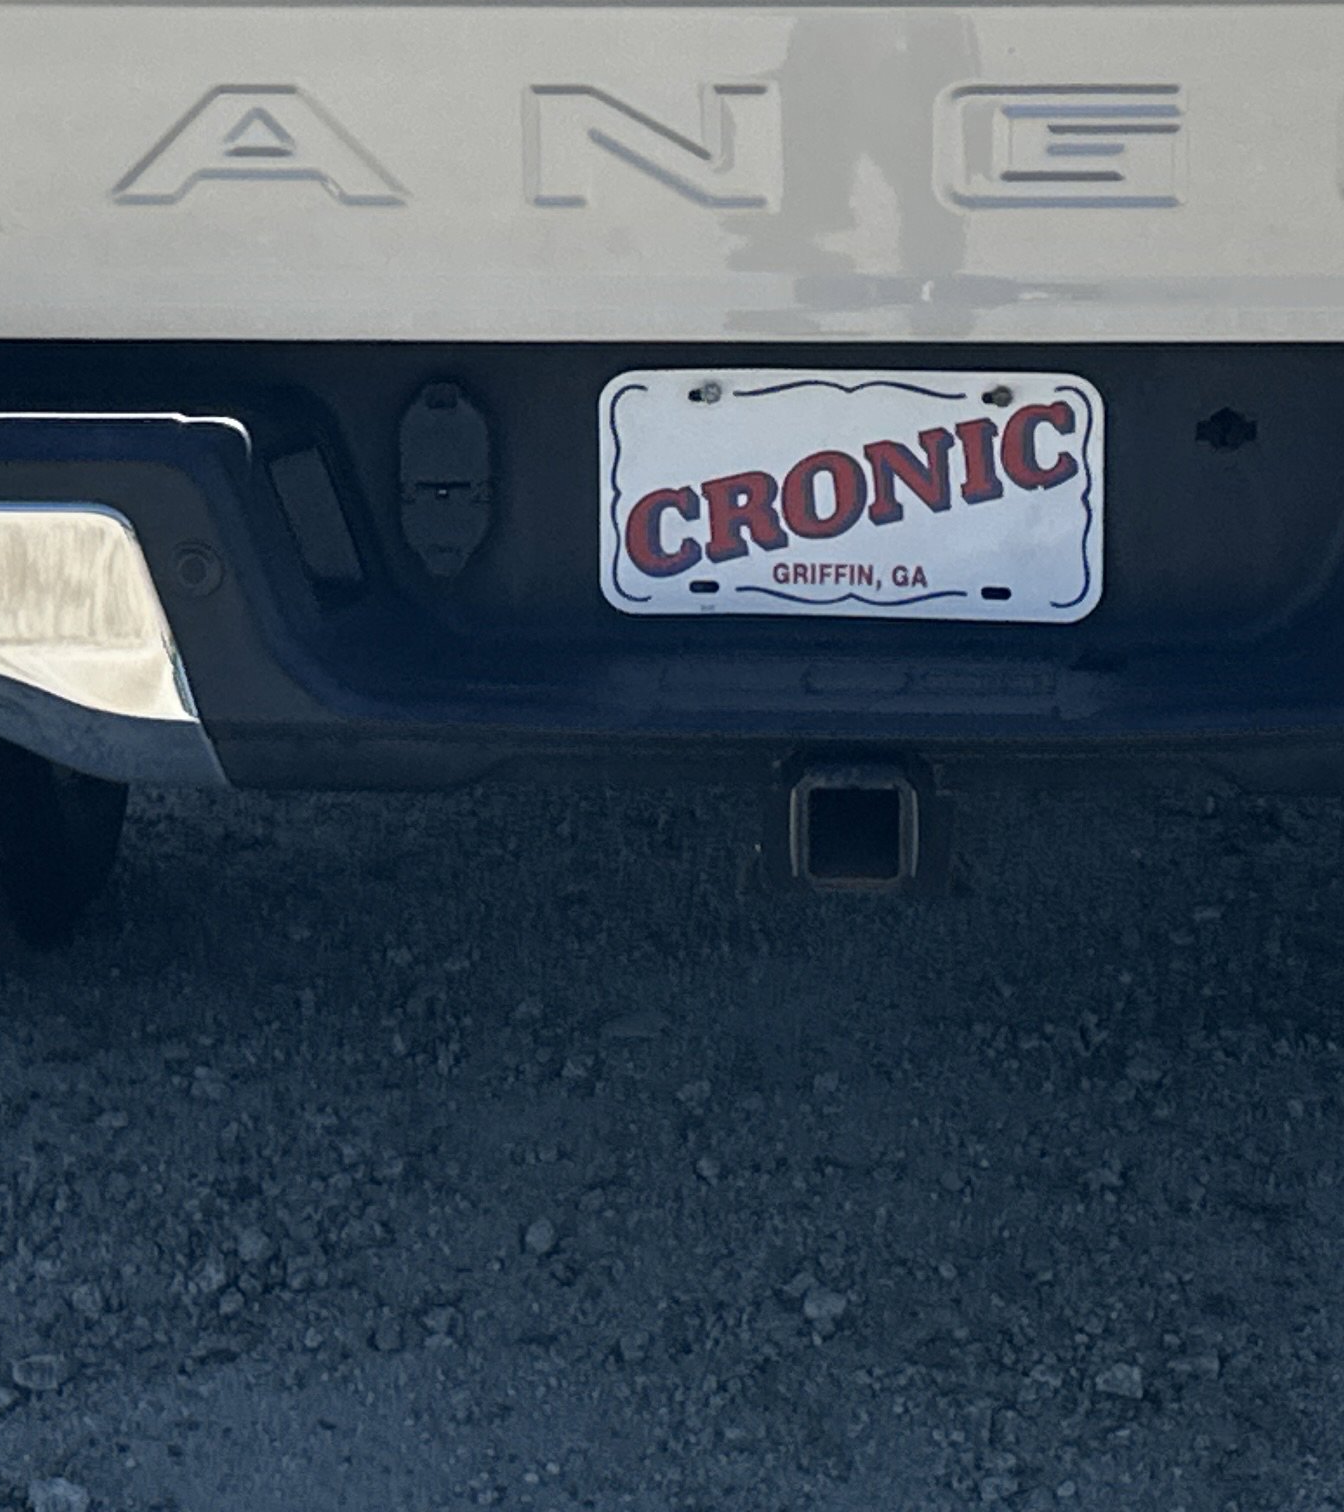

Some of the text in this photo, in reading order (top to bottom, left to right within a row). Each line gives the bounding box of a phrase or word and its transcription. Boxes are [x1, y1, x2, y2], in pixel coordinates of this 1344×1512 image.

[625, 401, 1078, 578] CRONIC
[772, 563, 929, 590] GRIFFIN, GA
